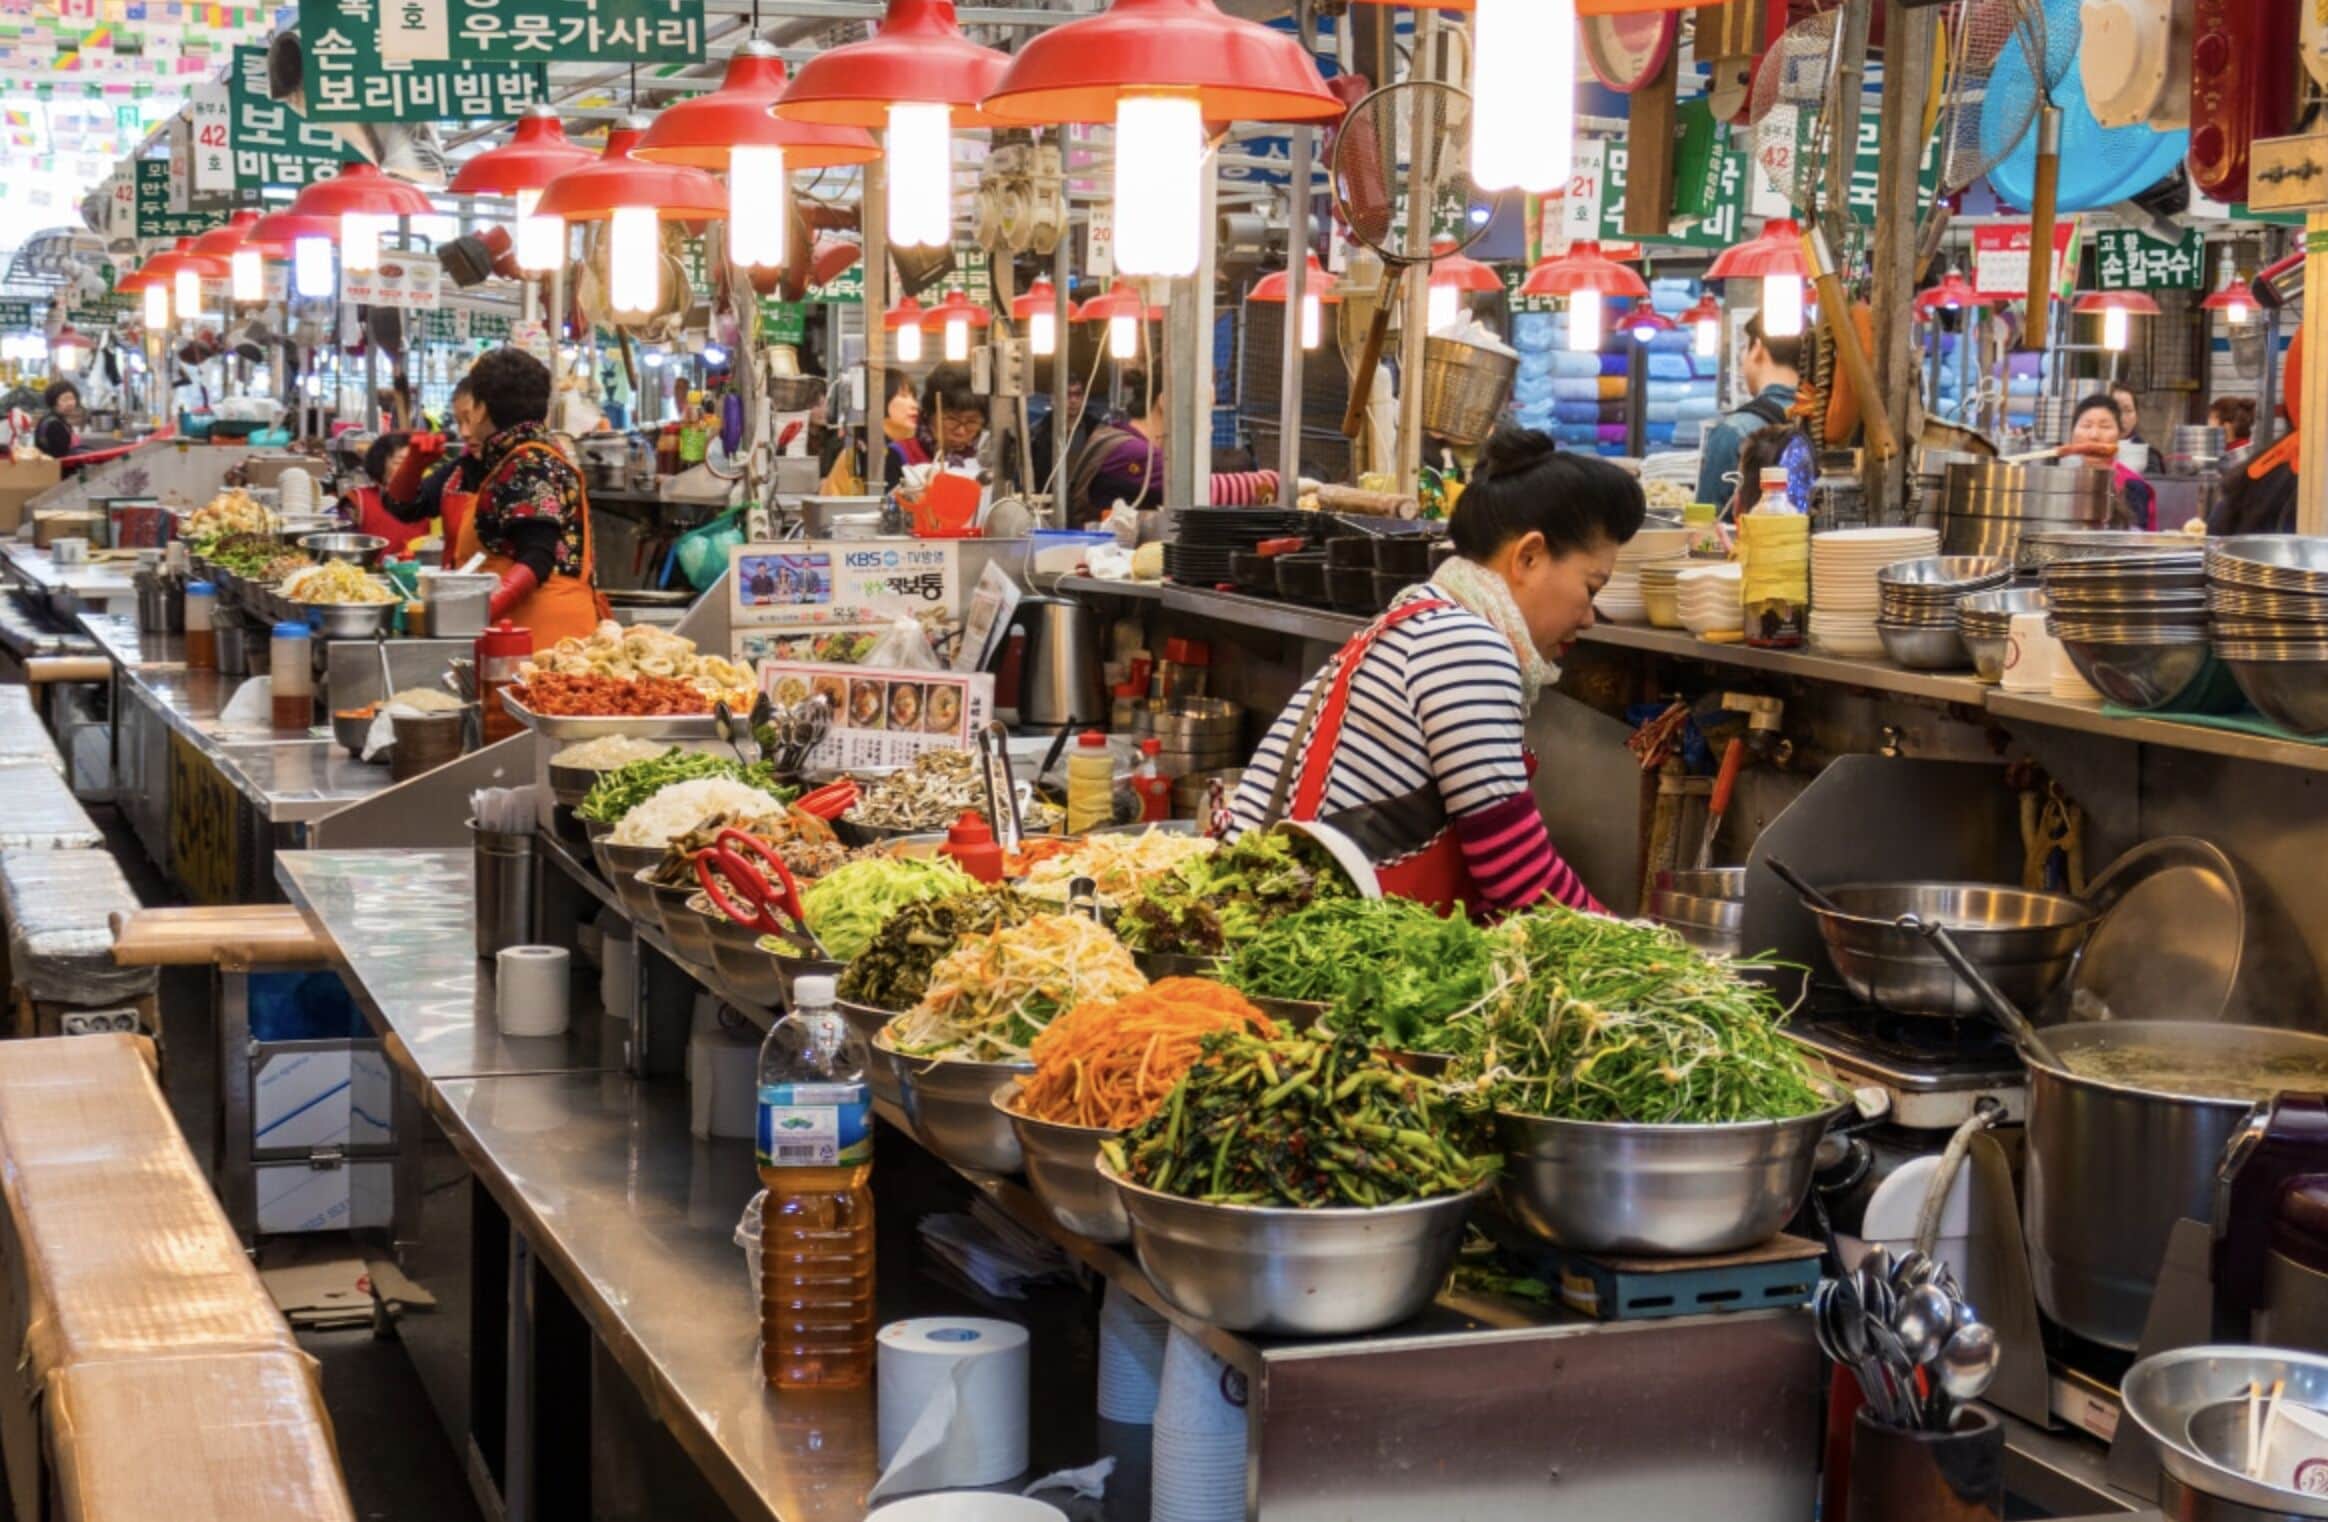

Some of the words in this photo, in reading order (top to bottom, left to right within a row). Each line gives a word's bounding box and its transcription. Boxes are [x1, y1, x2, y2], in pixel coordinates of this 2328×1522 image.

[458, 14, 699, 55] 우뭇가사리
[315, 73, 540, 117] 보리비빔밥
[199, 124, 228, 148] 42
[207, 153, 223, 171] 호
[1764, 146, 1789, 168] 42
[115, 184, 134, 202] 42
[1571, 175, 1595, 199] 21
[2100, 248, 2192, 288] 손칼국수
[845, 551, 881, 567] KBS
